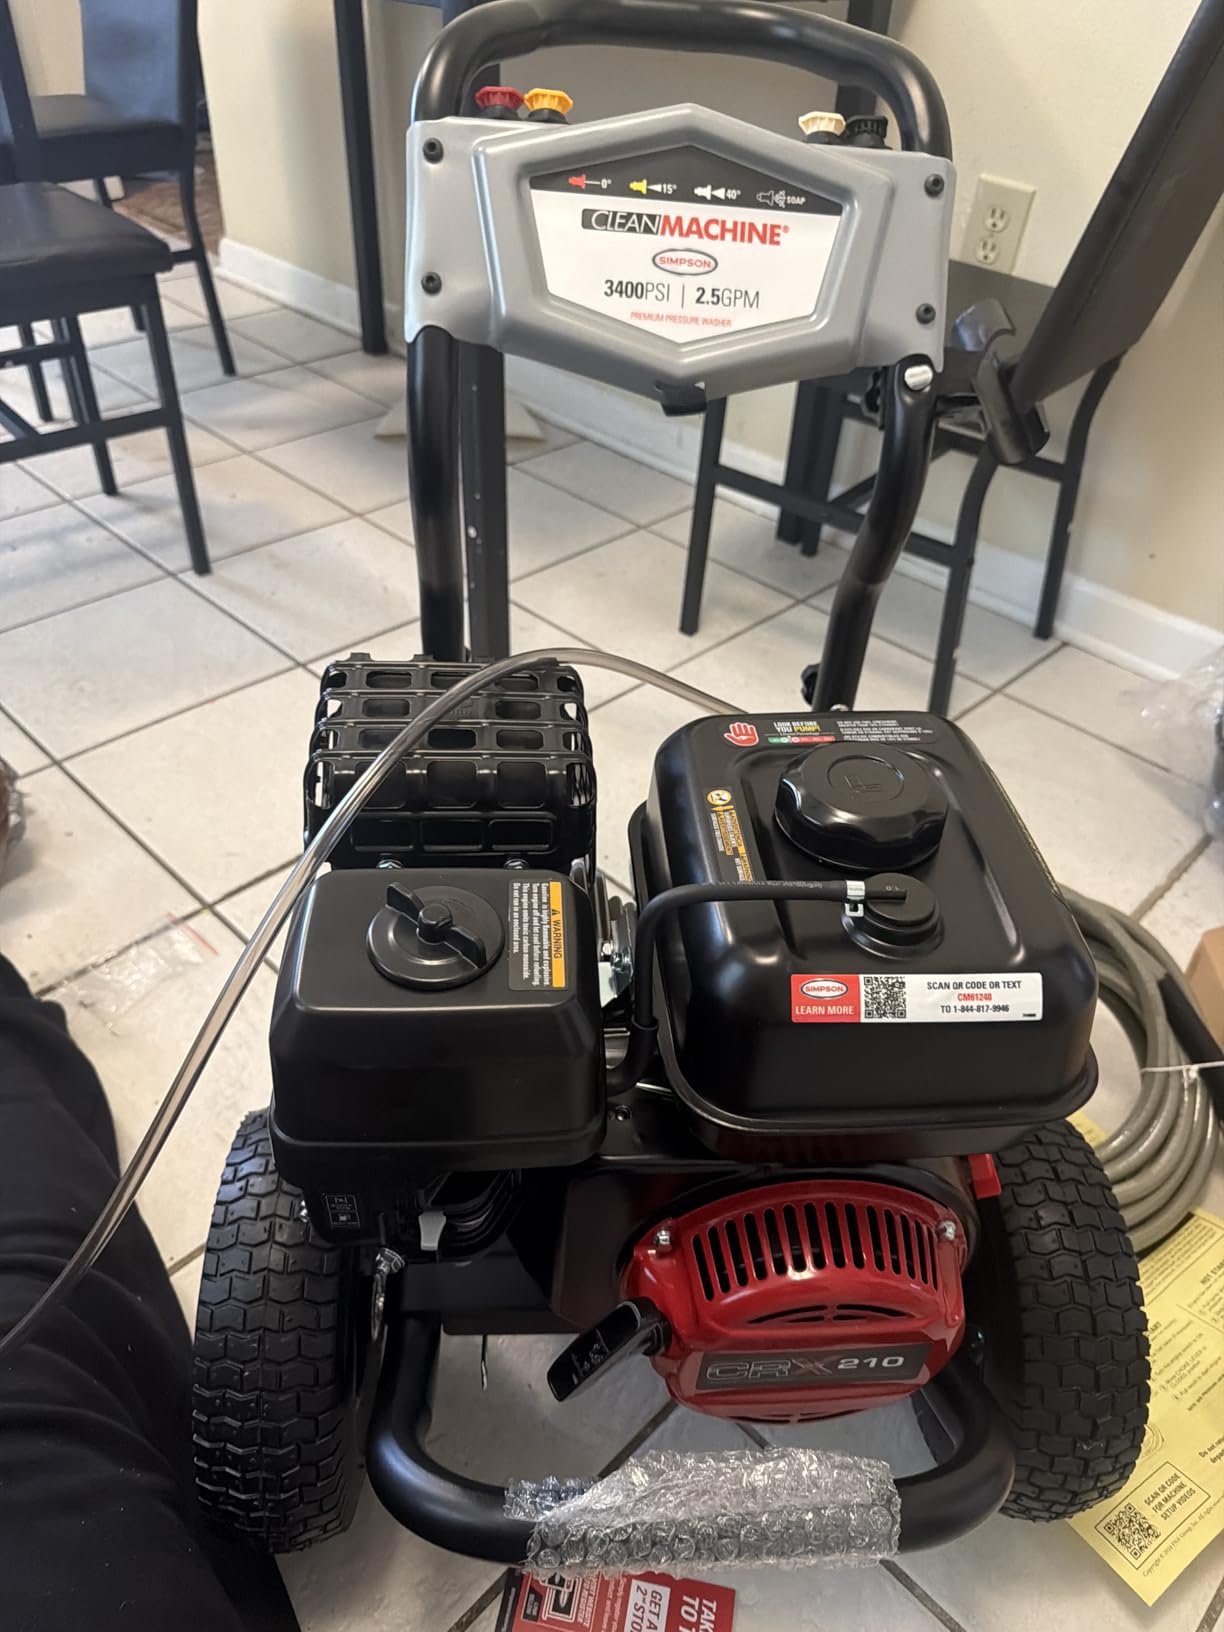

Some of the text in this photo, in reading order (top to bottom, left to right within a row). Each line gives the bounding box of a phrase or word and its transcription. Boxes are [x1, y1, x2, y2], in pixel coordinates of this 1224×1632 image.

[663, 184, 677, 194] 15°
[726, 189, 741, 200] 40°
[787, 196, 806, 205] SOAP
[659, 256, 712, 269] SIMPSON
[604, 279, 760, 309] 3400PSI 2.5GPM
[631, 312, 732, 327] PREMIUM PRESSURE WASHER
[521, 893, 530, 909] engine
[531, 893, 539, 909] engine
[541, 910, 549, 925] highly
[553, 920, 562, 958] WARNING
[927, 981, 1021, 990] SCAN QR CODE OR TEXT
[957, 993, 992, 1002] CM61248
[796, 1006, 854, 1015] LEARN MORE
[941, 1005, 1009, 1013] TO 1-844-817-9946
[706, 1356, 904, 1381] CRX 210
[1143, 1472, 1181, 1507] SCAN QR CODE
[1152, 1481, 1187, 1514] FOR MACHINE
[1160, 1487, 1196, 1521] SETUP VIDEOS
[1143, 1557, 1162, 1578] Copyright
[646, 1590, 662, 1630] GET A
[681, 1595, 699, 1622] TO
[699, 1598, 717, 1632] TAK
[630, 1603, 645, 1632] STO
